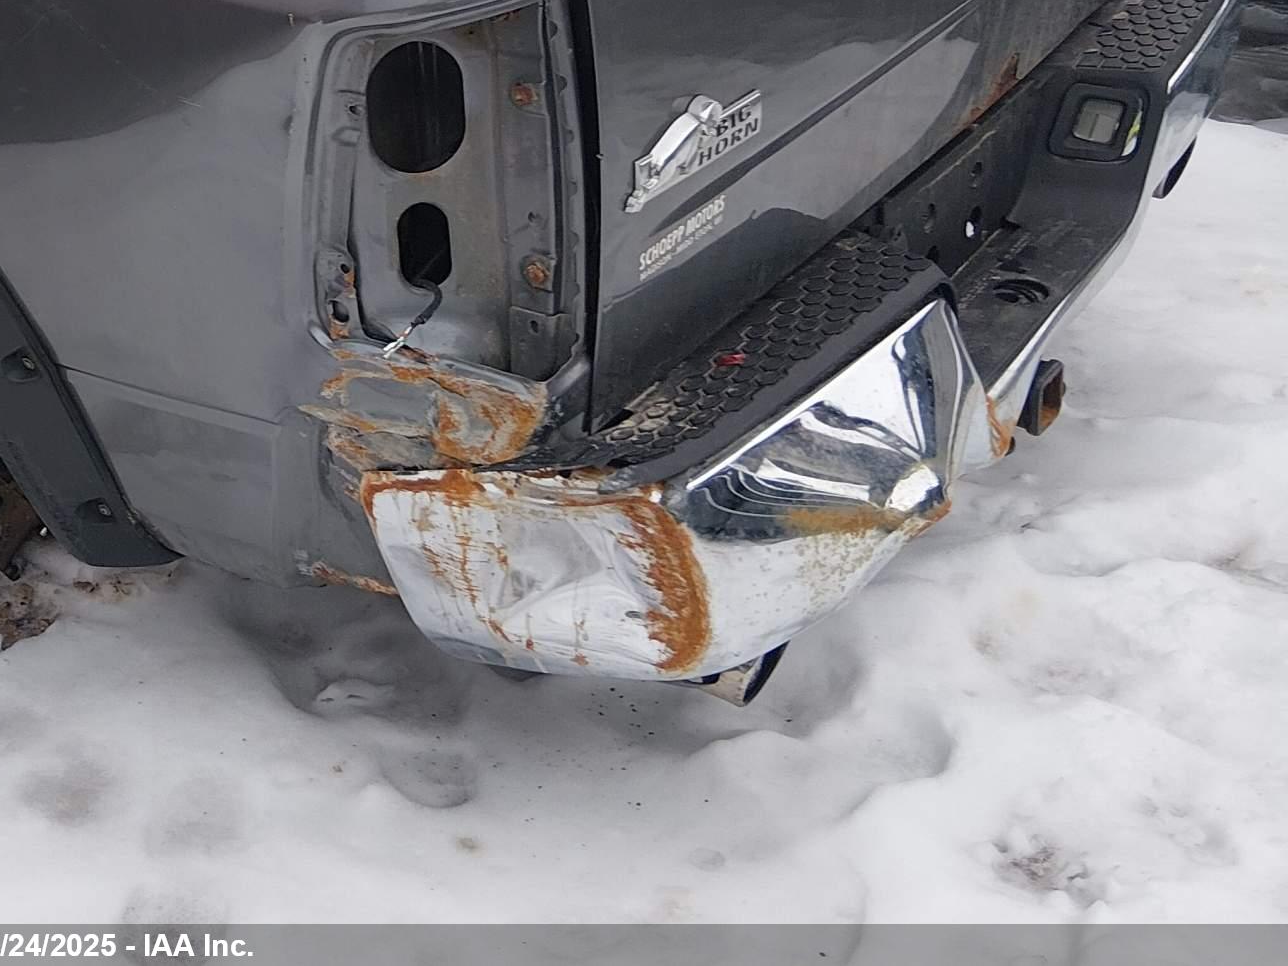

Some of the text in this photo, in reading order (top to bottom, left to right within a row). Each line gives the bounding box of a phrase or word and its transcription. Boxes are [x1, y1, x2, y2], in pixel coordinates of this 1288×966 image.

[697, 117, 758, 166] HORN
[715, 103, 752, 138] BIG
[639, 225, 684, 270] SCHOEPP
[685, 194, 726, 237] MOTORS
